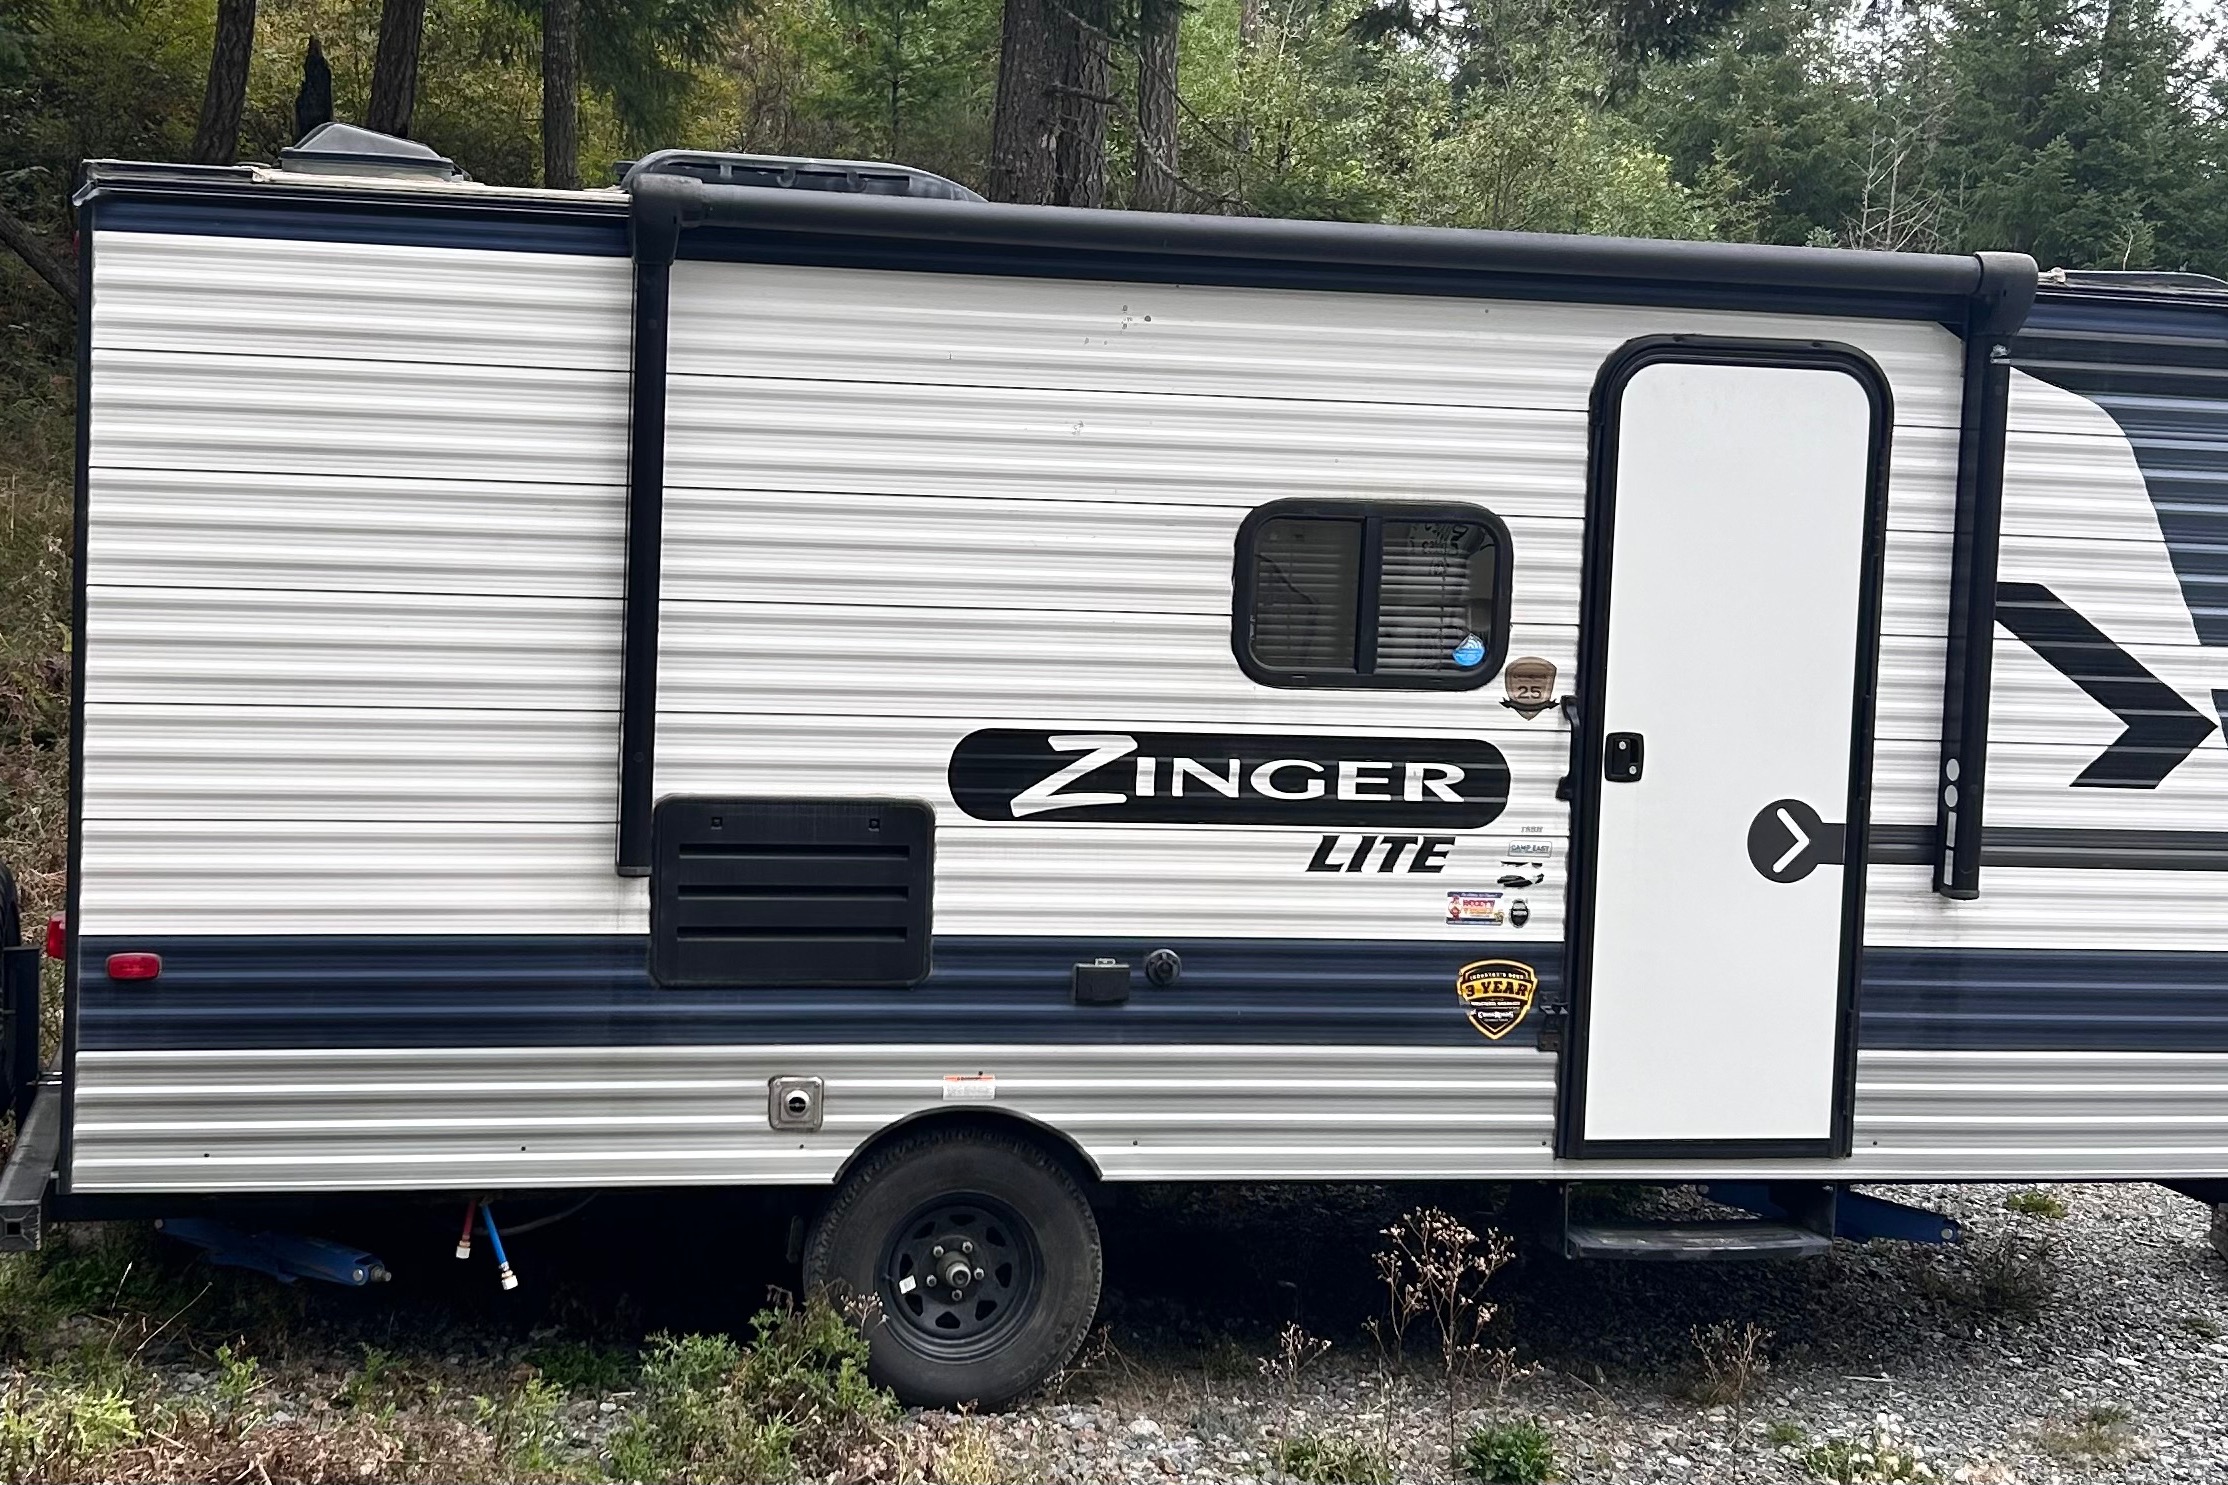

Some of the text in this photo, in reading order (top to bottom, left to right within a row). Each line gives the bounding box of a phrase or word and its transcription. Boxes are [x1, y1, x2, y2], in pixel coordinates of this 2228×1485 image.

[1517, 685, 1542, 699] 25
[1010, 735, 1466, 818] ZINGER
[1305, 834, 1456, 873] LITE
[1465, 980, 1528, 997] 3 YEAR
